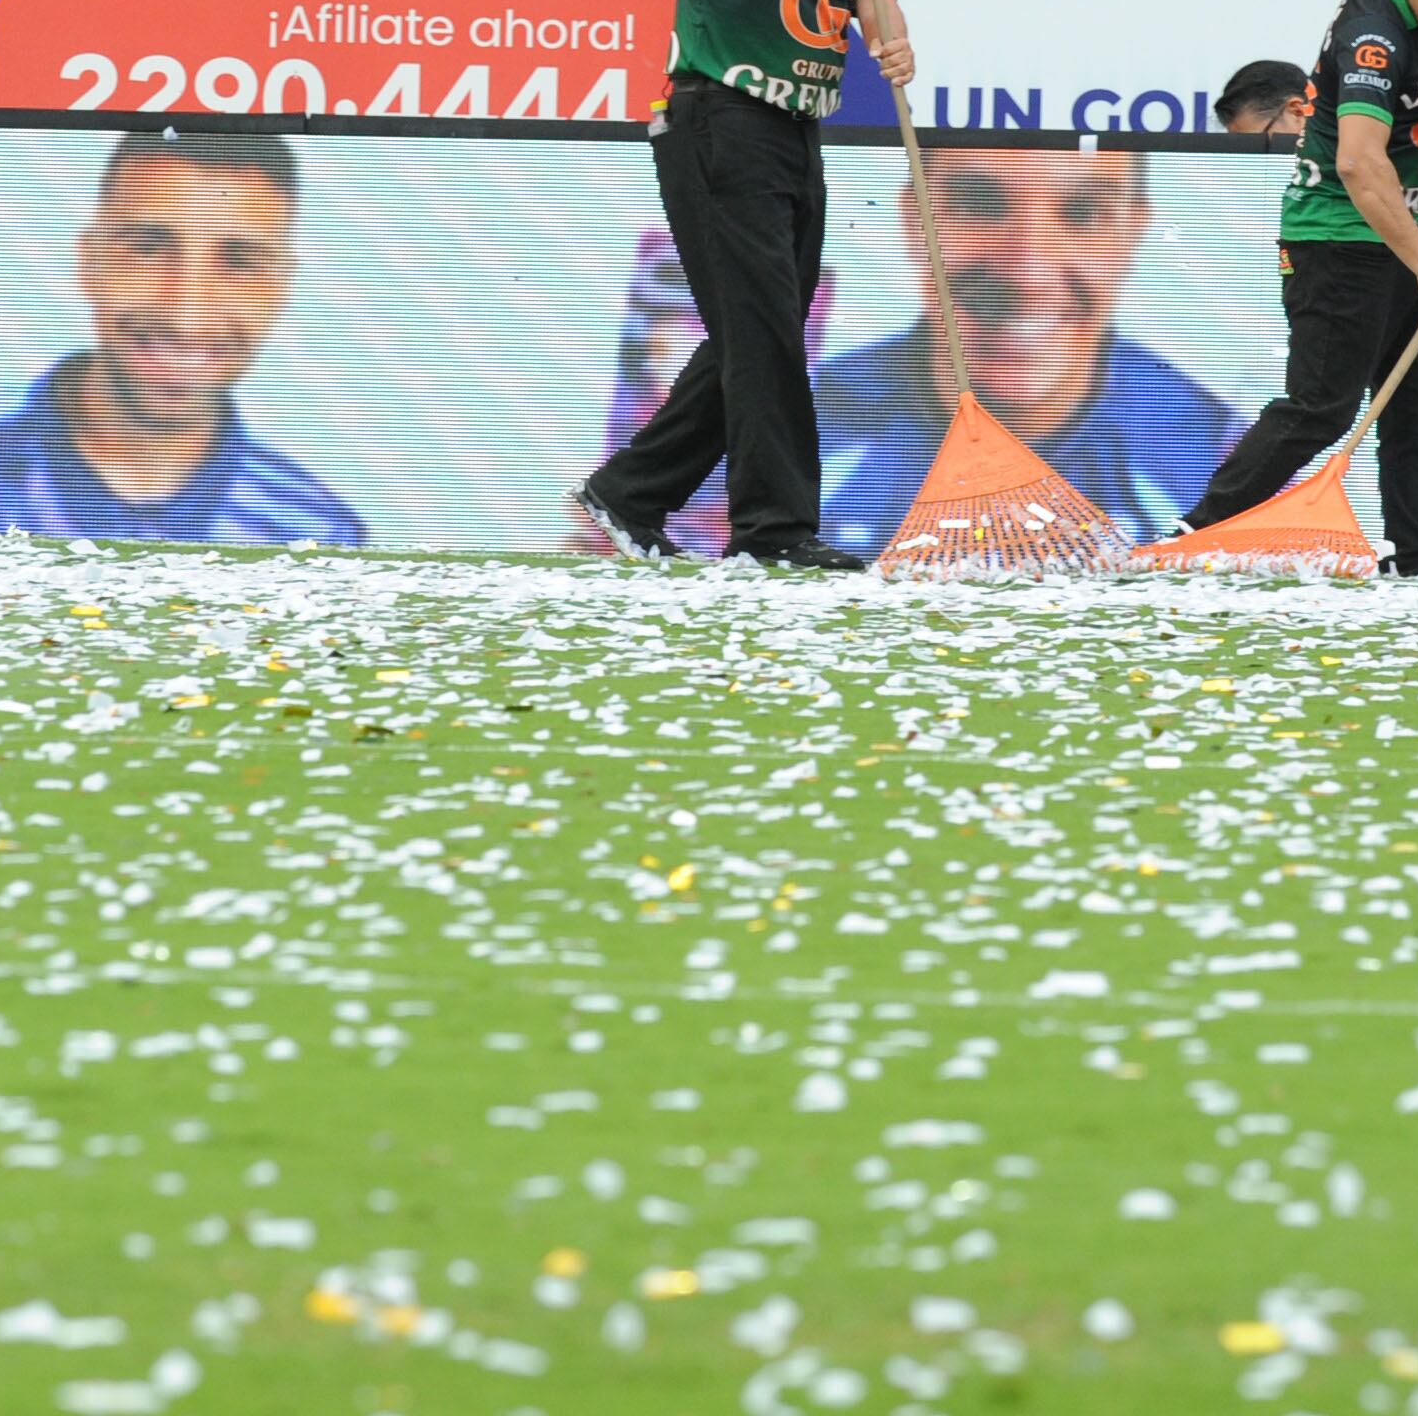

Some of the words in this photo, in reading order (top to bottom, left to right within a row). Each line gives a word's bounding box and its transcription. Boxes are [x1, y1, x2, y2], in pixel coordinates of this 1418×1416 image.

[267, 3, 455, 49] ¡Afiliate
[468, 9, 636, 50] ahora!
[1342, 72, 1392, 91] GREMIO
[934, 85, 1043, 132] UN
